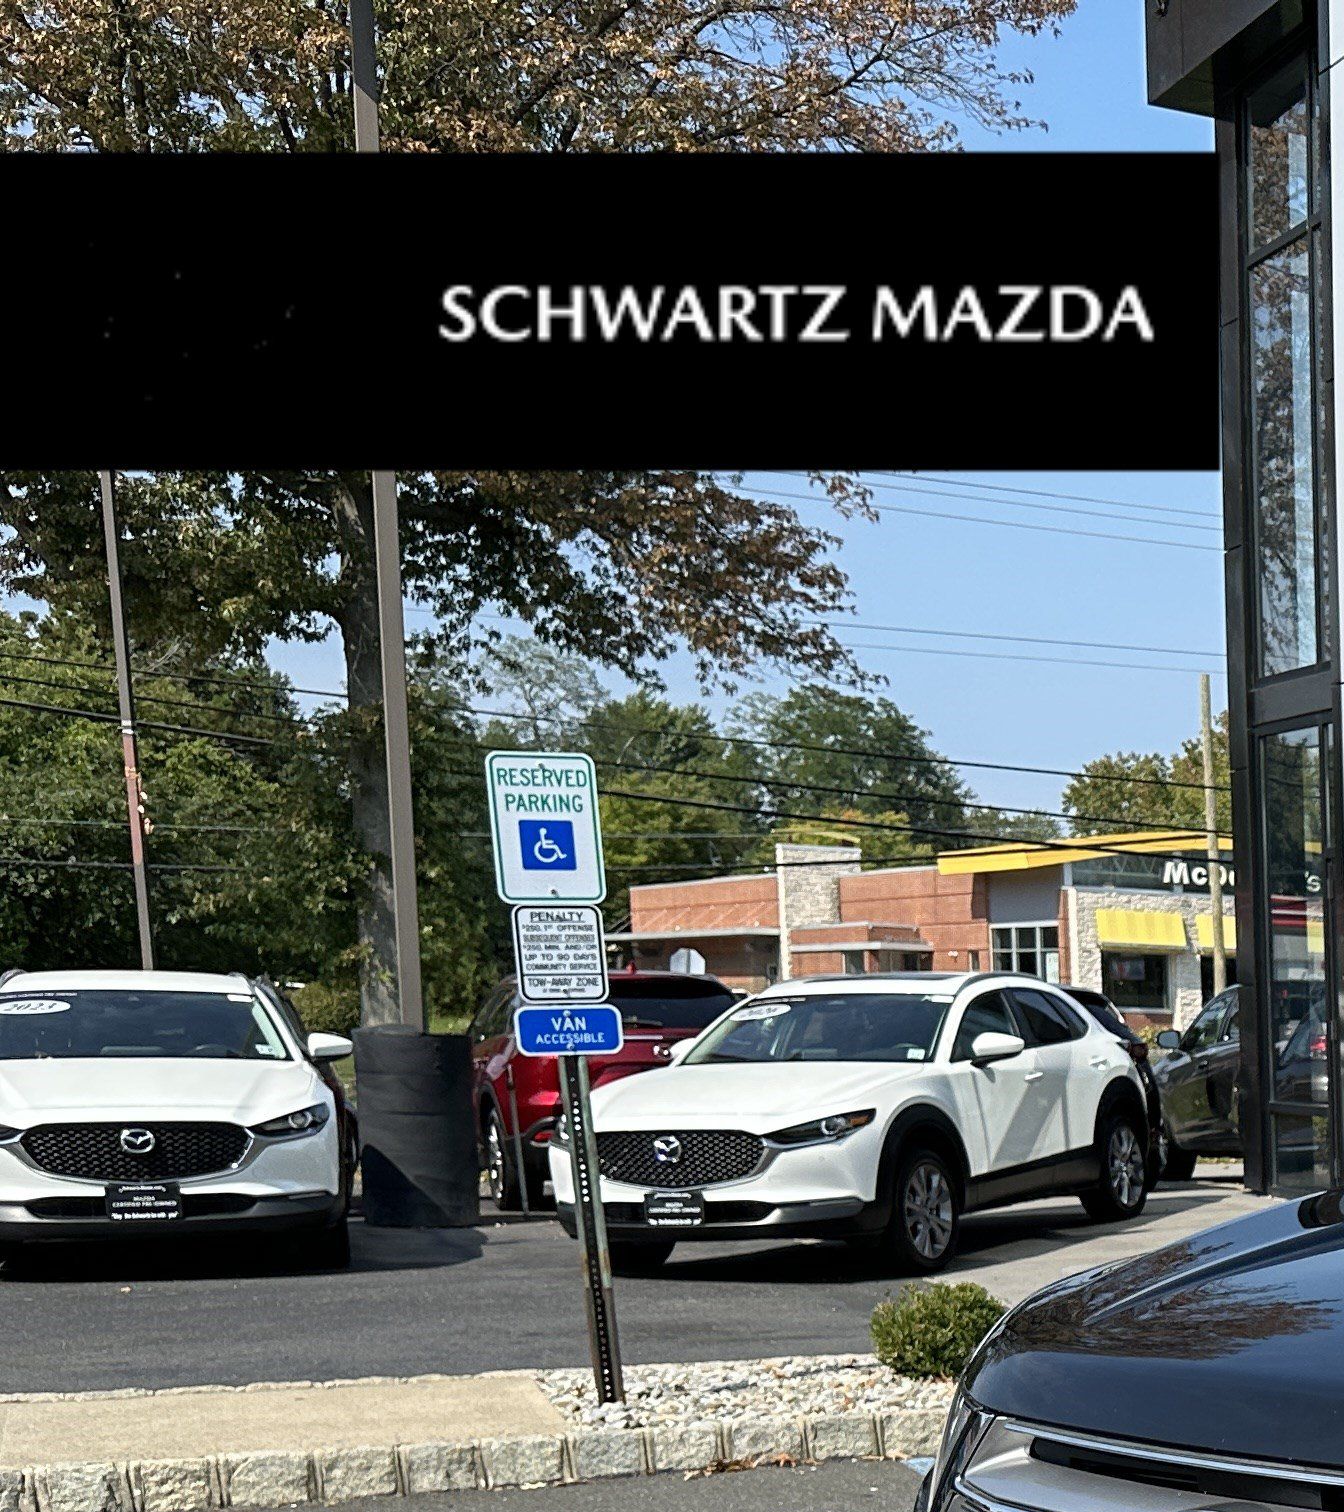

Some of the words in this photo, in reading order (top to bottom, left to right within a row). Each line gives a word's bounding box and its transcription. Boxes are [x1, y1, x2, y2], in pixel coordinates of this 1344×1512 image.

[496, 768, 587, 787] RESERVED
[504, 793, 583, 812] PARKING
[530, 911, 584, 921] PENALTY
[524, 953, 537, 961] UP
[556, 953, 570, 961] 90
[528, 977, 572, 987] TOW-AWAY
[576, 977, 599, 987] ZONE
[551, 1016, 587, 1031] VAN
[535, 1032, 605, 1044] ACCESSIBLE
